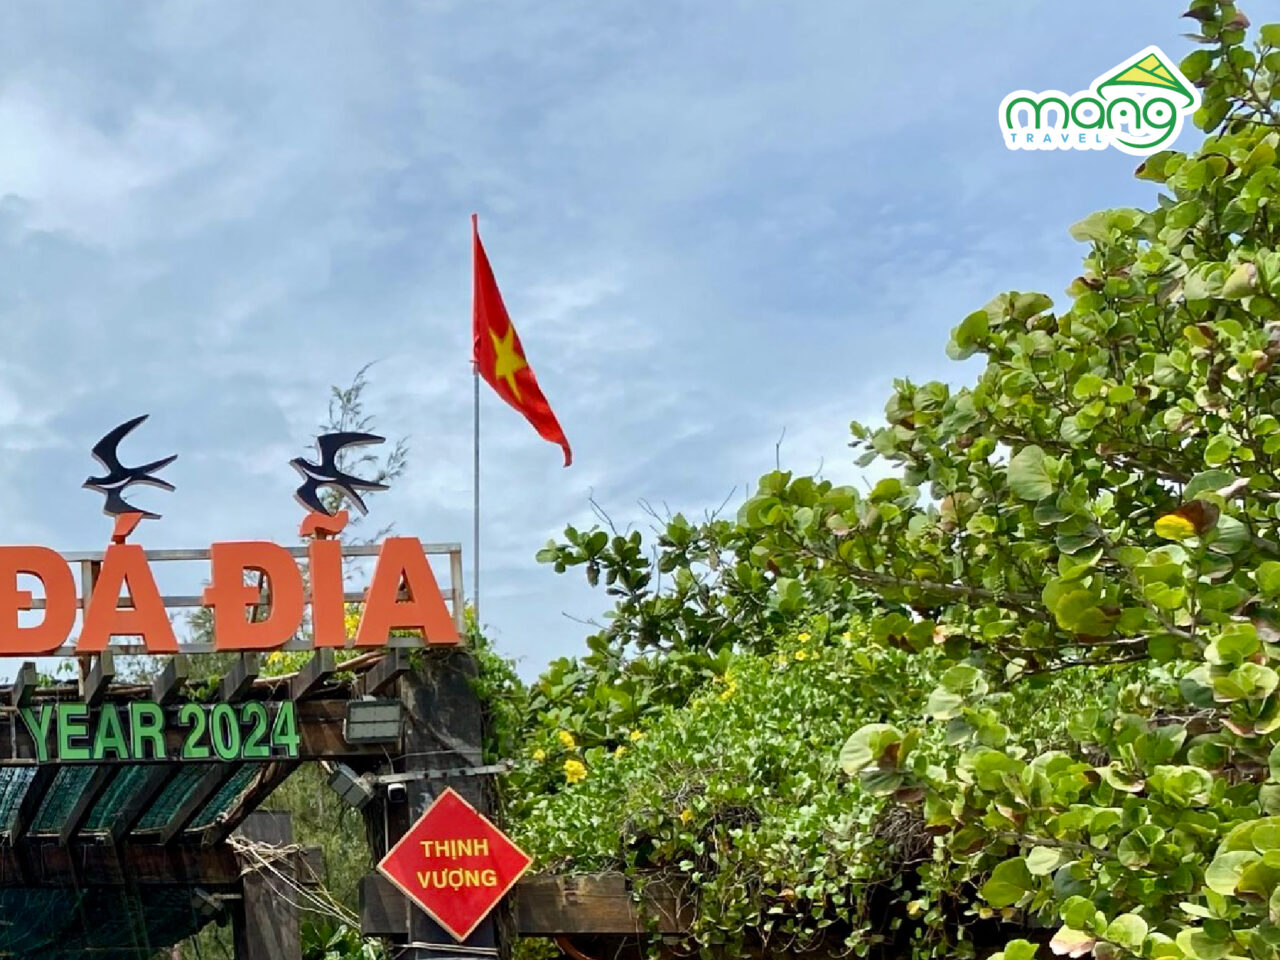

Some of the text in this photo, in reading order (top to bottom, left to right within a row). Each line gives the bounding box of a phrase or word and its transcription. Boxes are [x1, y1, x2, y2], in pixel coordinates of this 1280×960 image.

[204, 511, 459, 649] ĐĨA
[20, 701, 167, 763] YEAR
[177, 700, 301, 762] 2024
[420, 839, 489, 860] THỊNH
[417, 868, 497, 891] VƯỢNG
